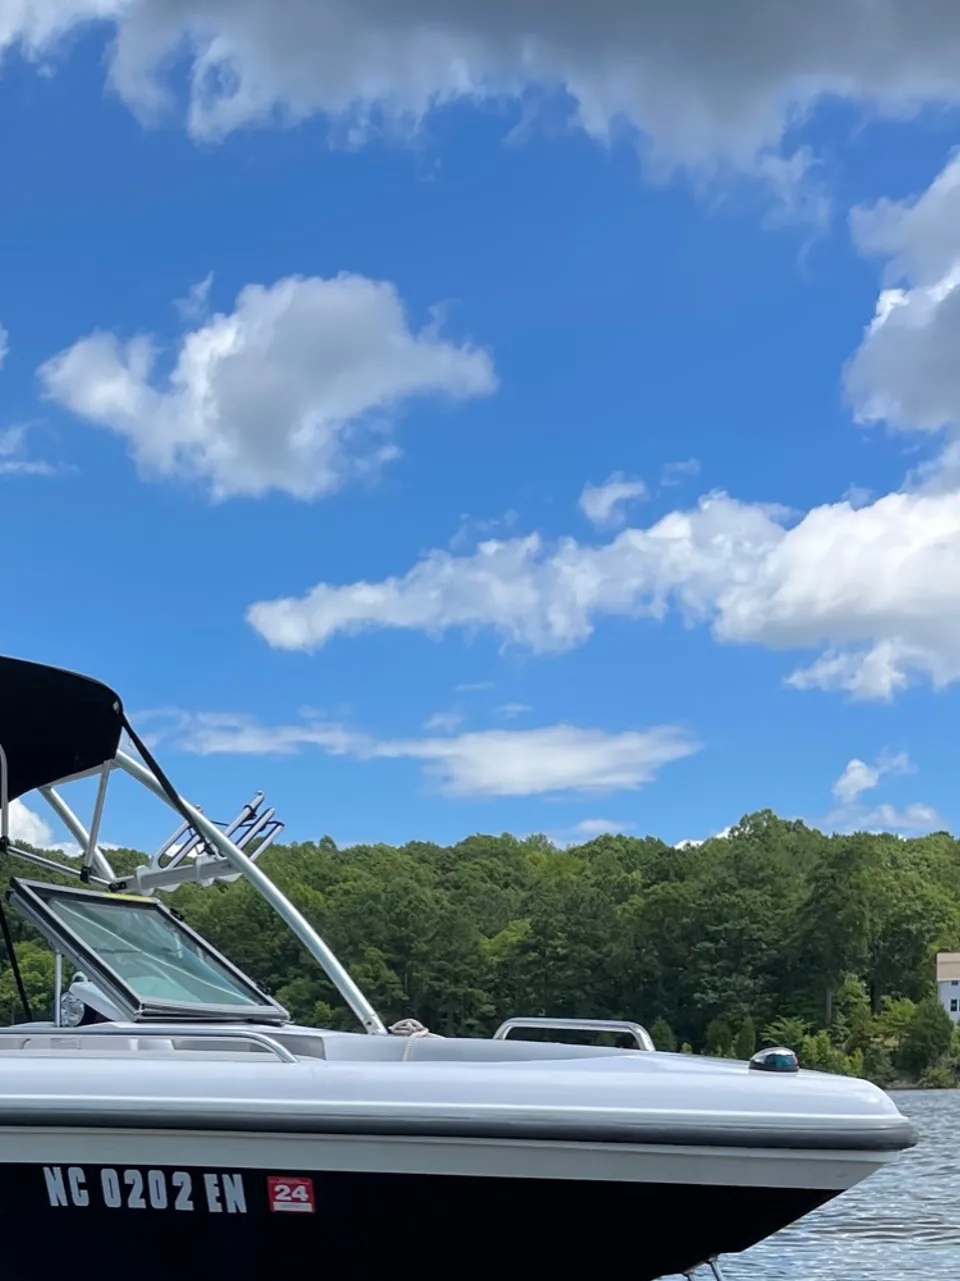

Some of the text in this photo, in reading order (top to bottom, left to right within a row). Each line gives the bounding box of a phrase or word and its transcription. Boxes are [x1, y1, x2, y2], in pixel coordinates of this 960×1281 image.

[42, 1166, 248, 1214] NC 0202 EN
[274, 1184, 309, 1202] 24
